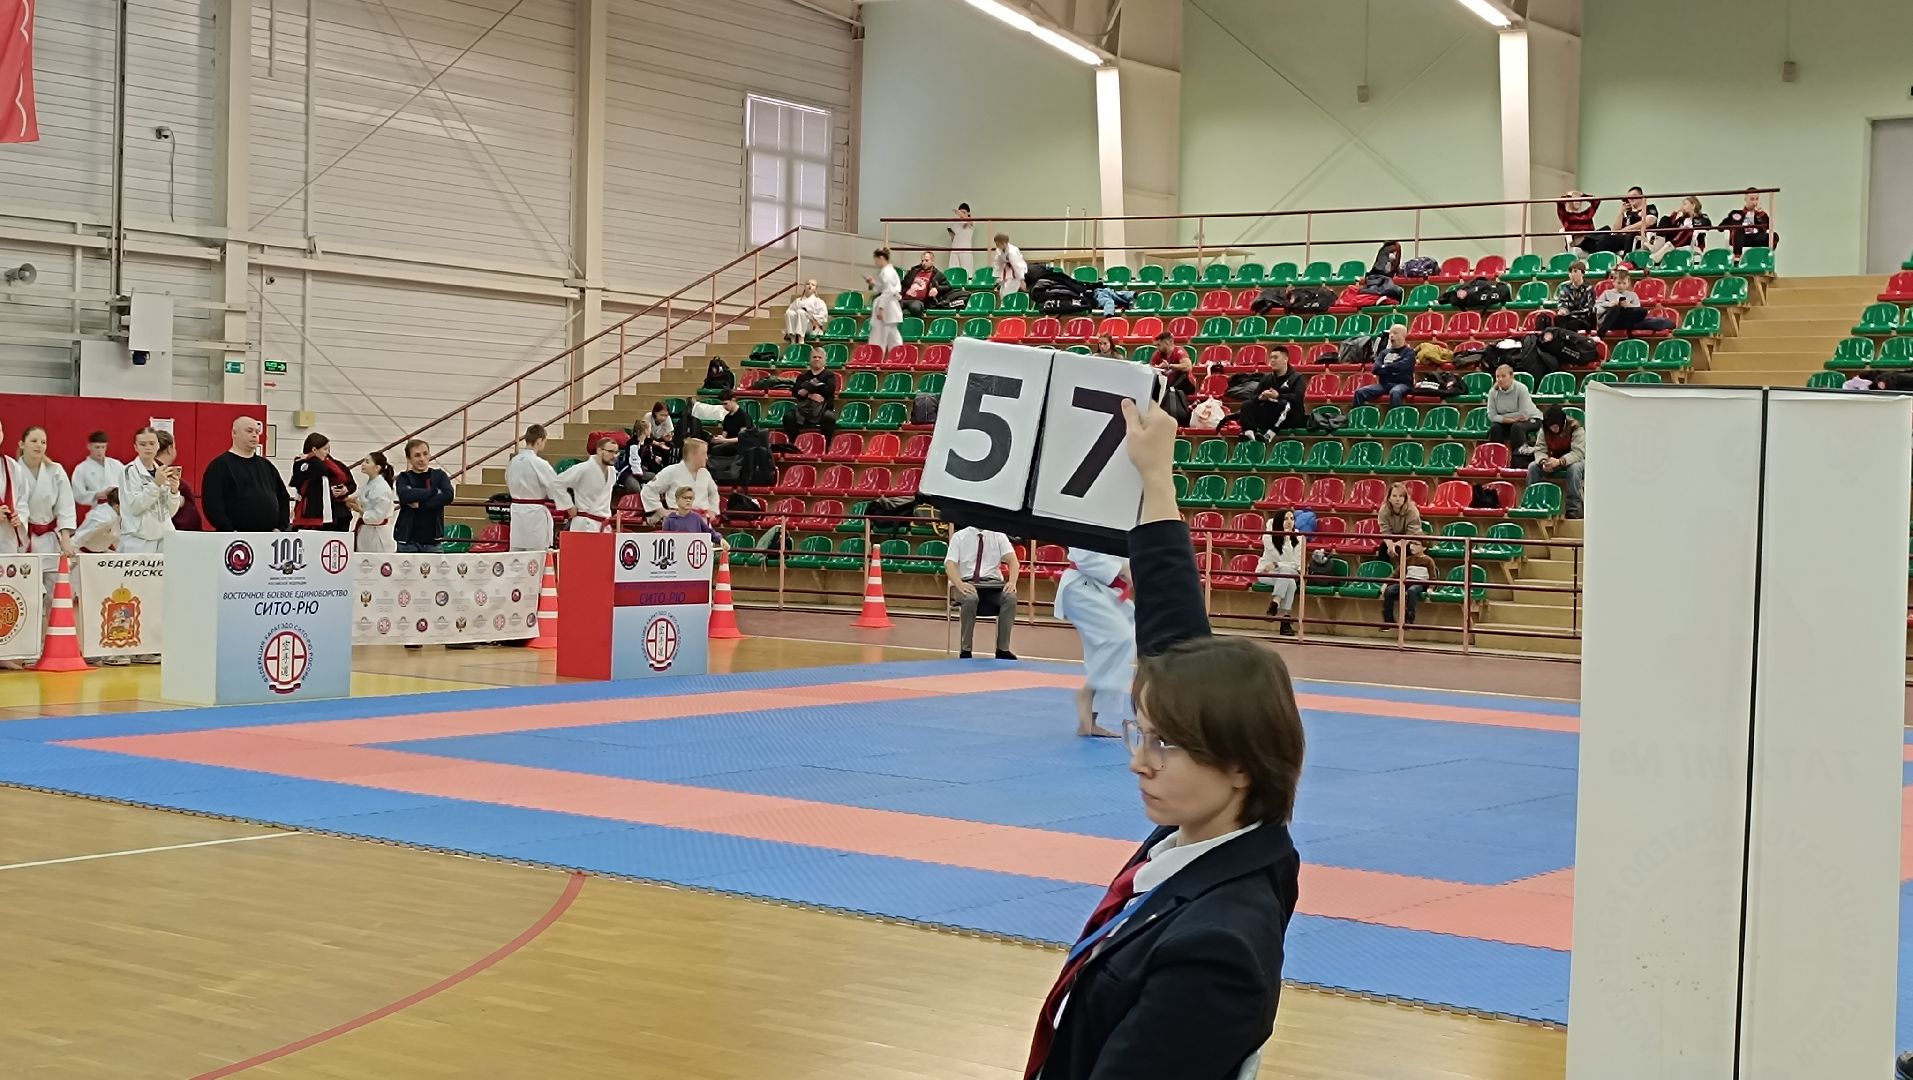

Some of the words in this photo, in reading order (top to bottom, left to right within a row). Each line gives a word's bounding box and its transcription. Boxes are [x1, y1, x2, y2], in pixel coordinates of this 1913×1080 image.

[945, 372, 1136, 498] 57
[223, 591, 264, 600] ВОСТОЧНОЕ
[267, 590, 294, 598] БОЕВОЕ
[295, 589, 348, 598] ЕДИНОБОРСТВО
[254, 600, 319, 616] СИТО-РЮ
